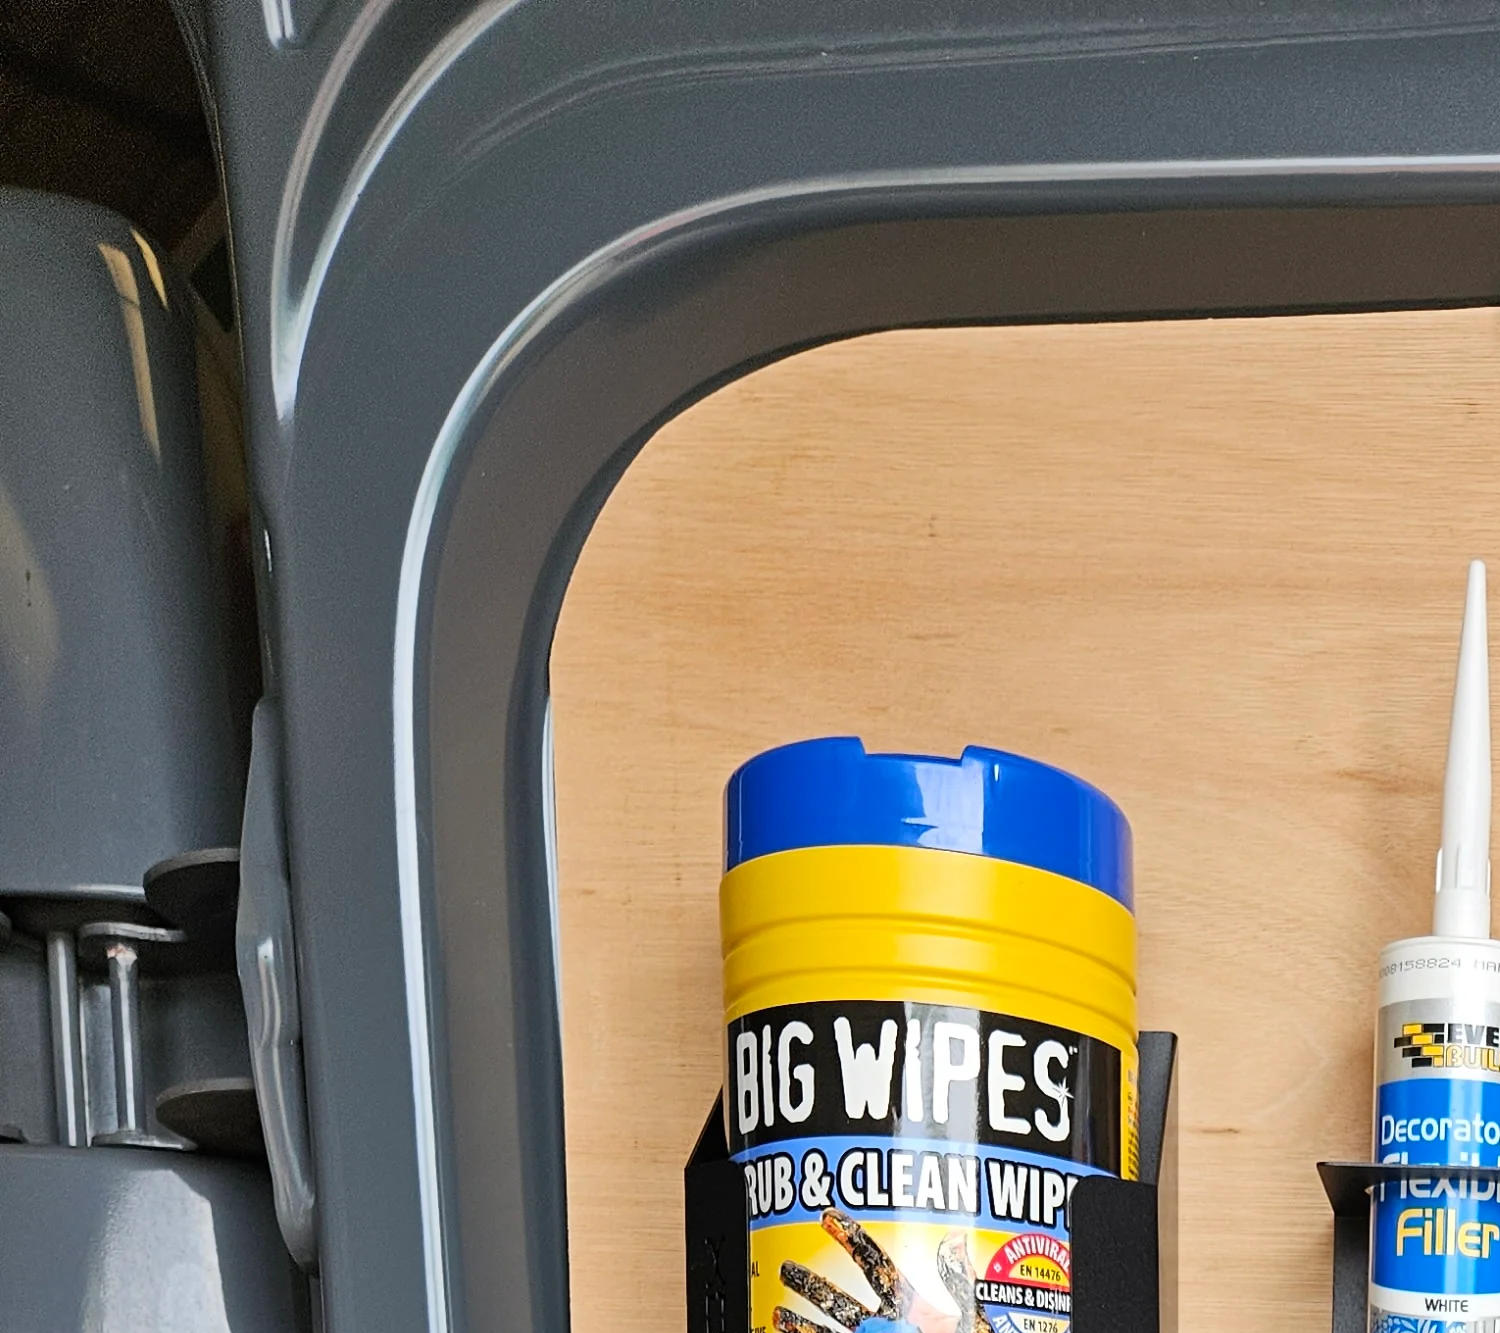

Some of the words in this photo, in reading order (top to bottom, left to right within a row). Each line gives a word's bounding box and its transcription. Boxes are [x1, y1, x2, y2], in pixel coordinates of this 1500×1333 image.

[735, 1019, 815, 1135] BIG
[833, 1015, 1072, 1142] WIPES
[802, 1152, 832, 1207] &
[840, 1151, 977, 1213] CLEAN
[1396, 1207, 1500, 1259] Filler
[1020, 1264, 1033, 1278] EN
[1035, 1266, 1061, 1282] 14476
[975, 1282, 1023, 1305] CLEANS
[1024, 1287, 1035, 1307] &
[1425, 1297, 1469, 1313] WHITE
[1023, 1318, 1035, 1331] EN
[1038, 1321, 1058, 1333] 1276
